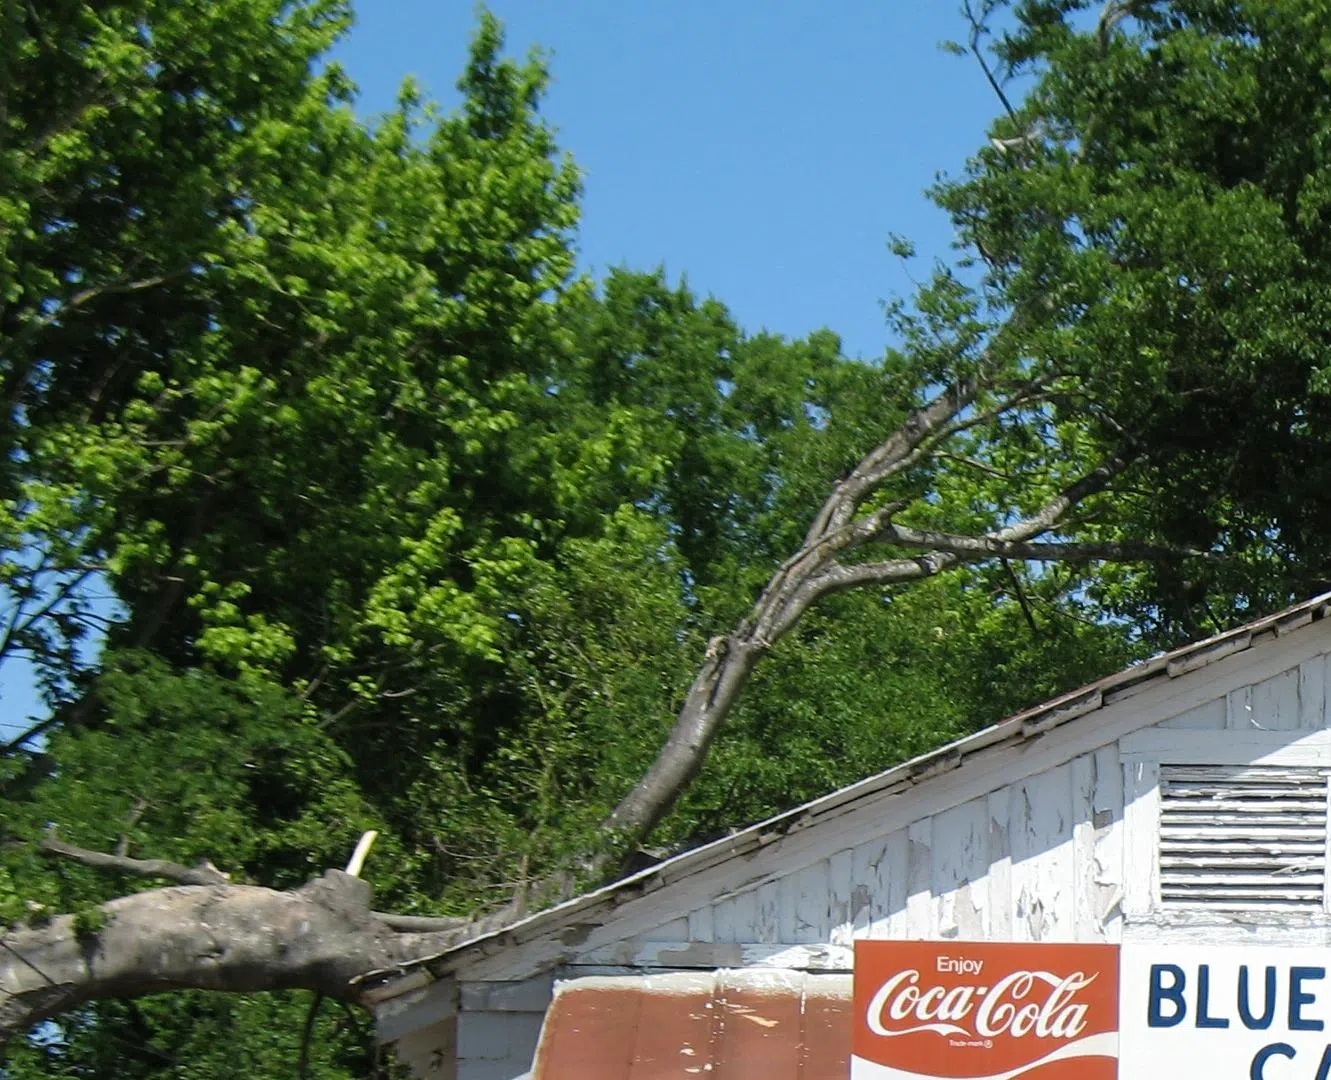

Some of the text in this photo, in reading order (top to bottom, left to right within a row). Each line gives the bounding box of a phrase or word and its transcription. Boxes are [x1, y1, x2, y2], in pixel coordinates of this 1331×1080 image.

[936, 956, 984, 975] Enjoy
[1147, 963, 1326, 1032] BLUE
[867, 969, 1100, 1038] Coca-Cola
